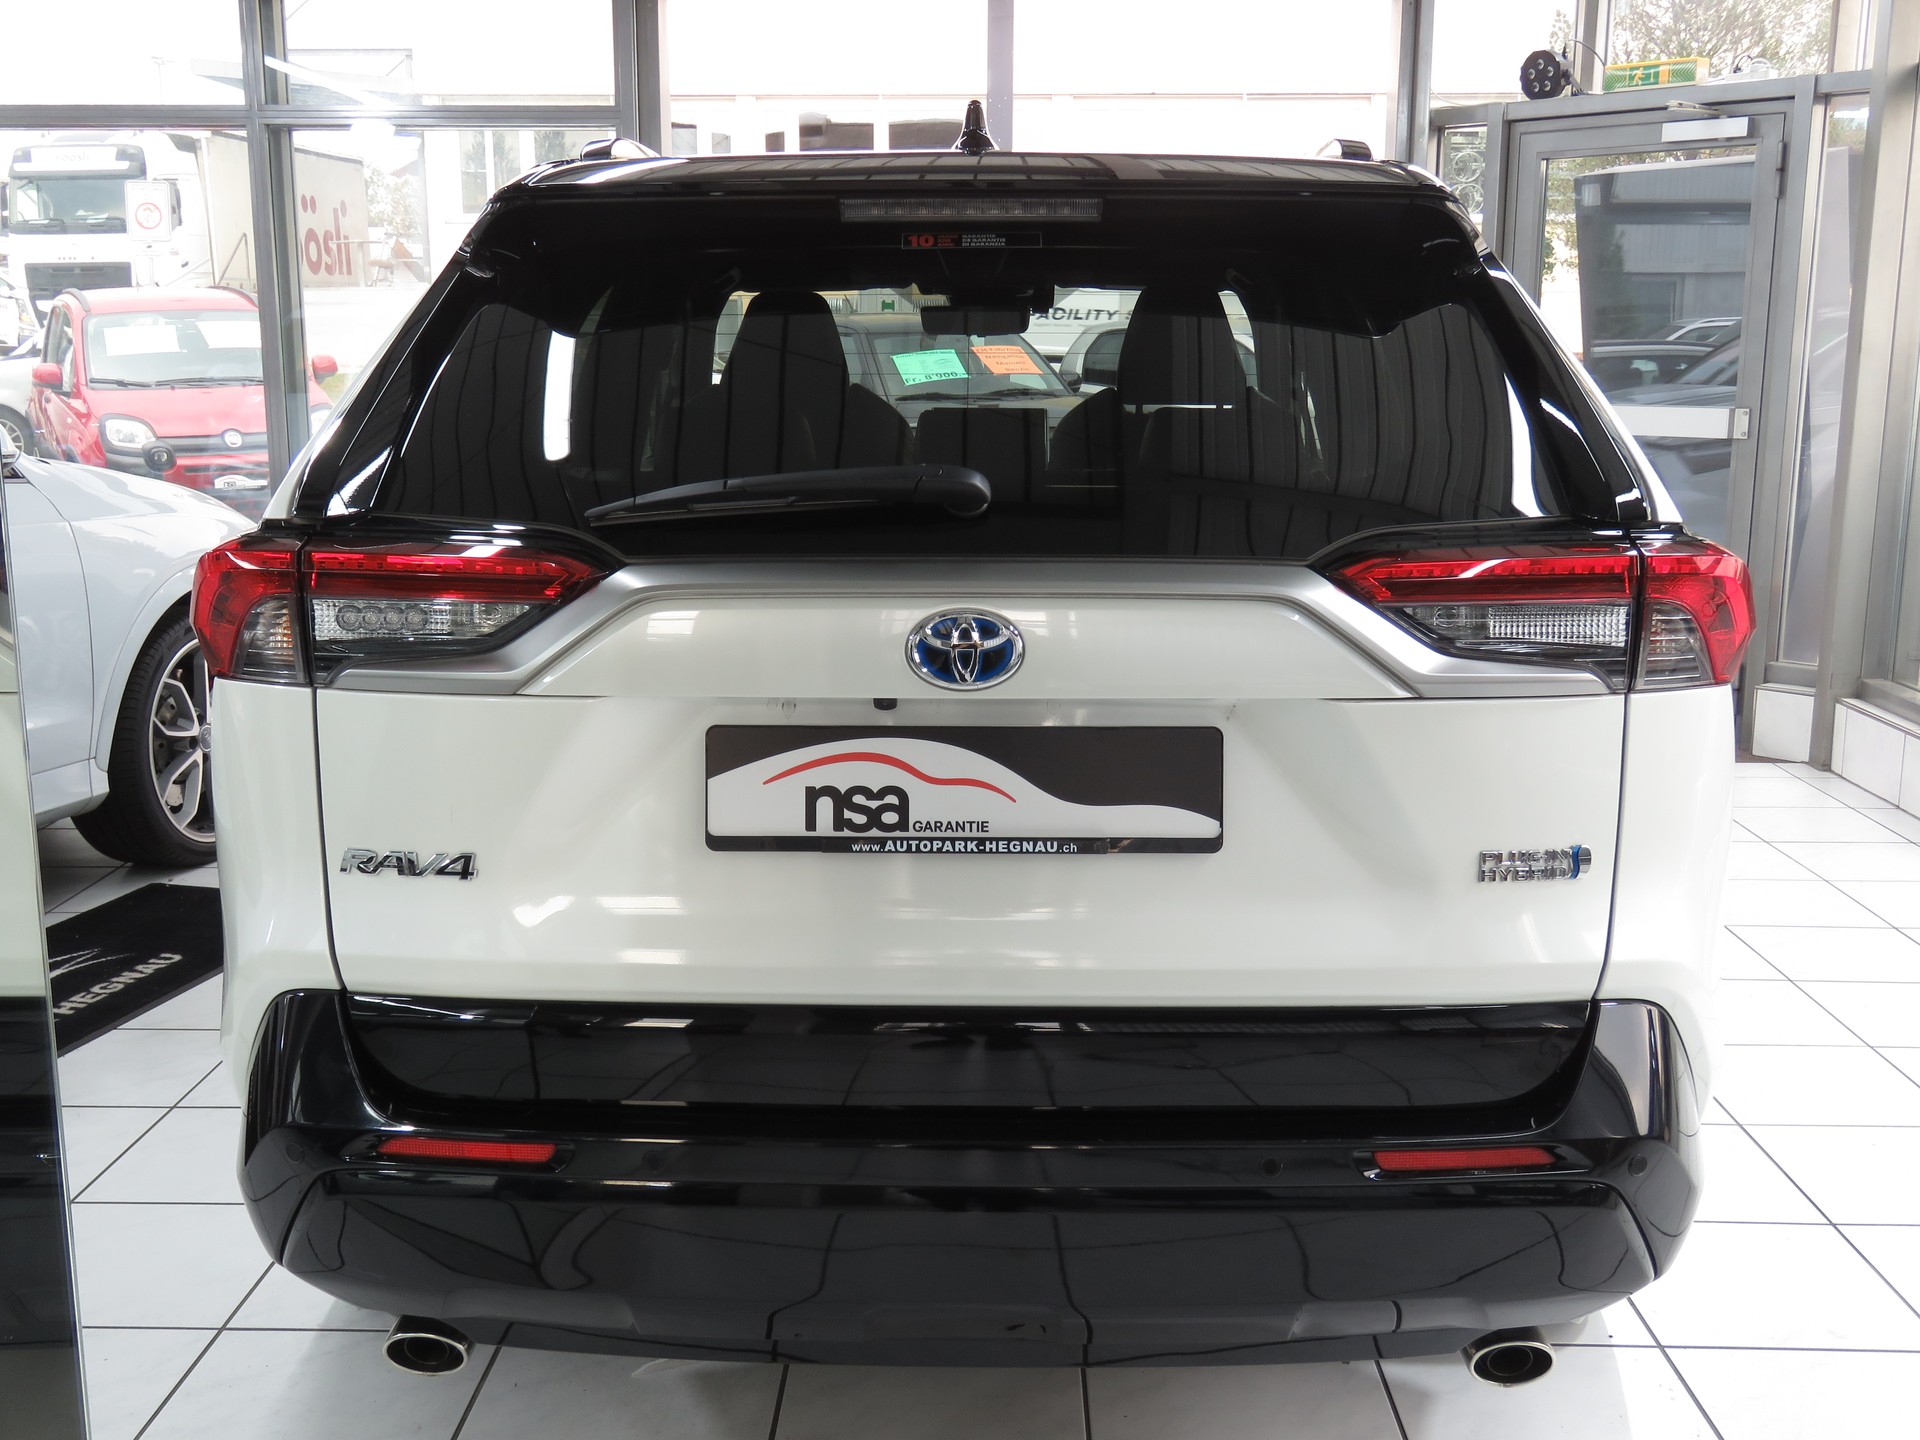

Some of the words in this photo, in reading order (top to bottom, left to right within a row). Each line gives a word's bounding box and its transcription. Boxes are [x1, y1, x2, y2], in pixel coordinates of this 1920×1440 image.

[300, 194, 352, 276] ösli
[908, 234, 934, 248] 10
[805, 785, 910, 833] nsa
[912, 820, 990, 833] GARANTIE
[851, 840, 1078, 853] www.AUTOPARK-HEGNAU.ch
[339, 847, 478, 881] RAV4
[1479, 849, 1572, 866] PLUG-IN
[1478, 866, 1568, 883] HYBRID
